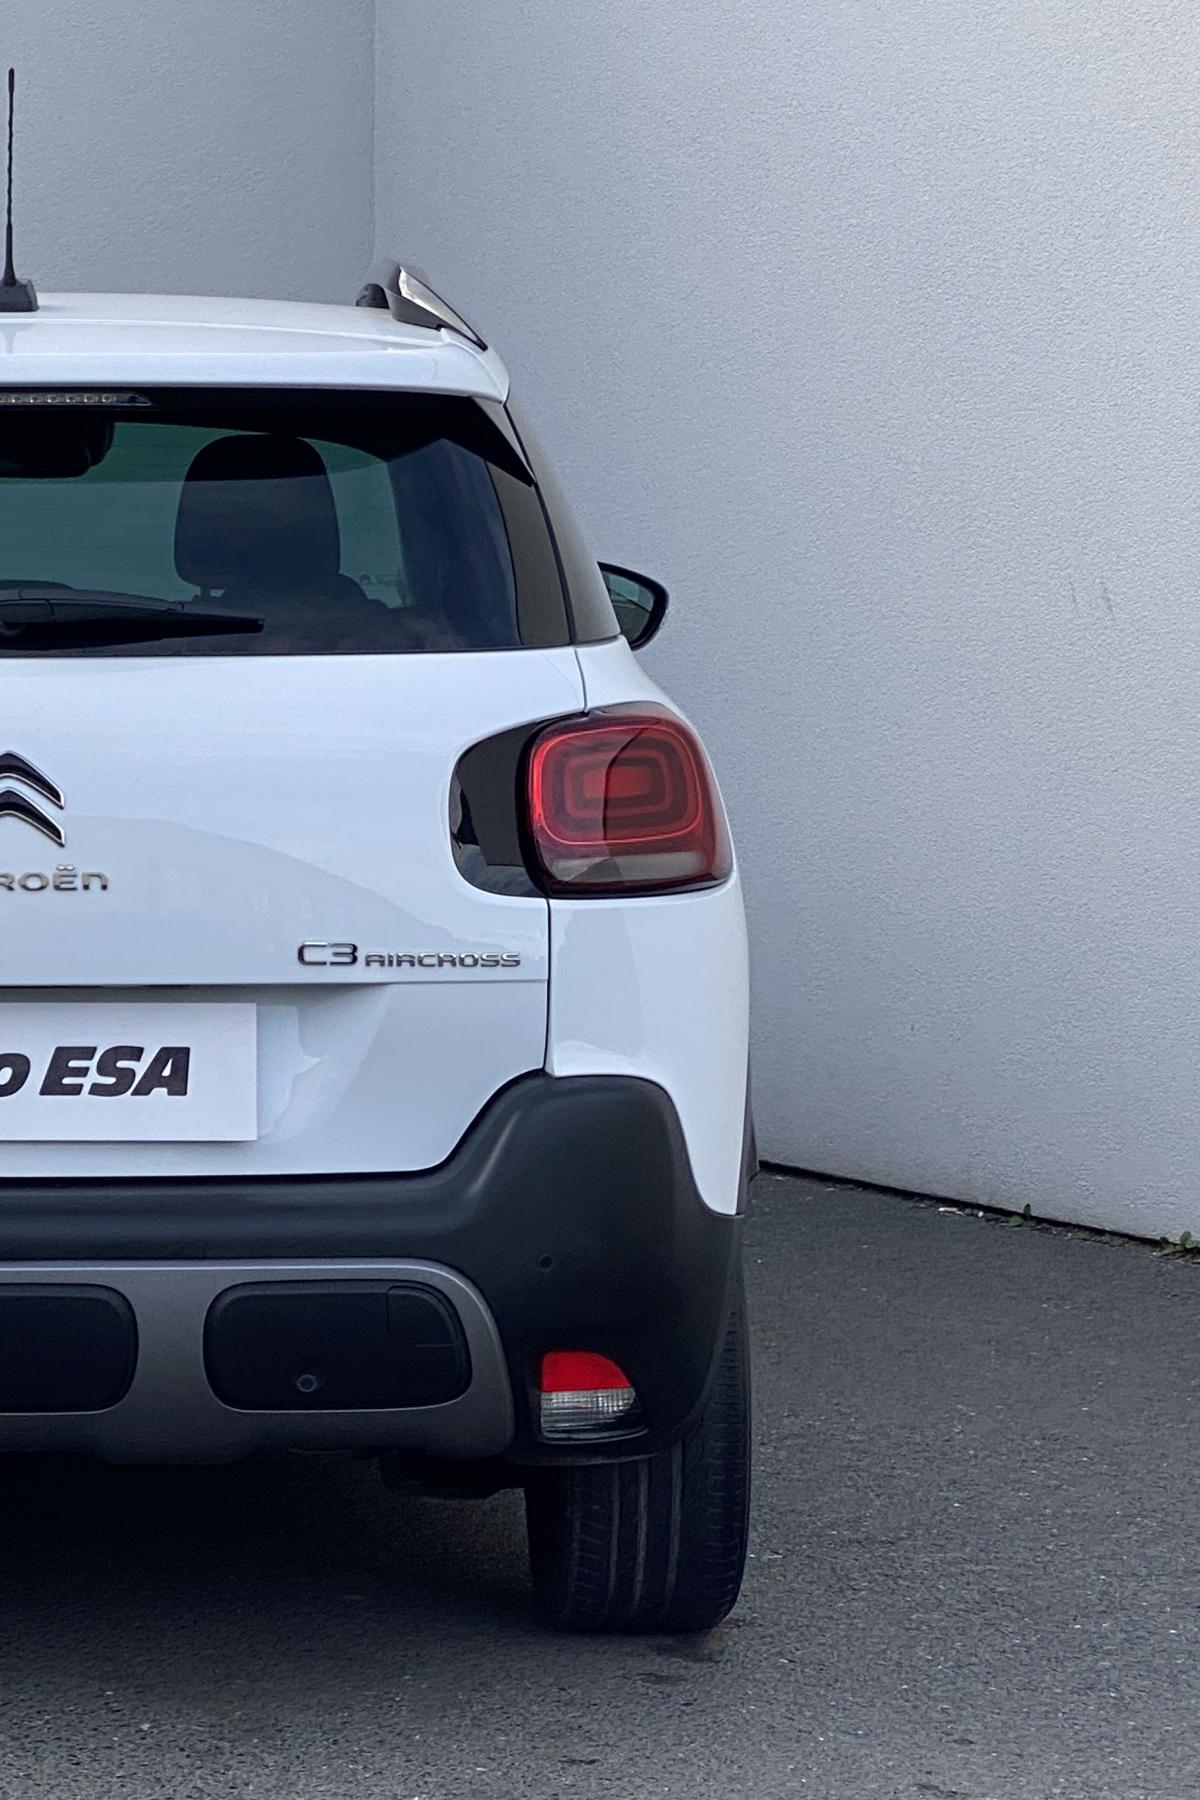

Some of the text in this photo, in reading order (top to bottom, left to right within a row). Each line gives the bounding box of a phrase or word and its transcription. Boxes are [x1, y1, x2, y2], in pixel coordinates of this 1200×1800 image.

[297, 941, 521, 968] C3 AIRCROSS
[39, 1044, 190, 1098] ESA
